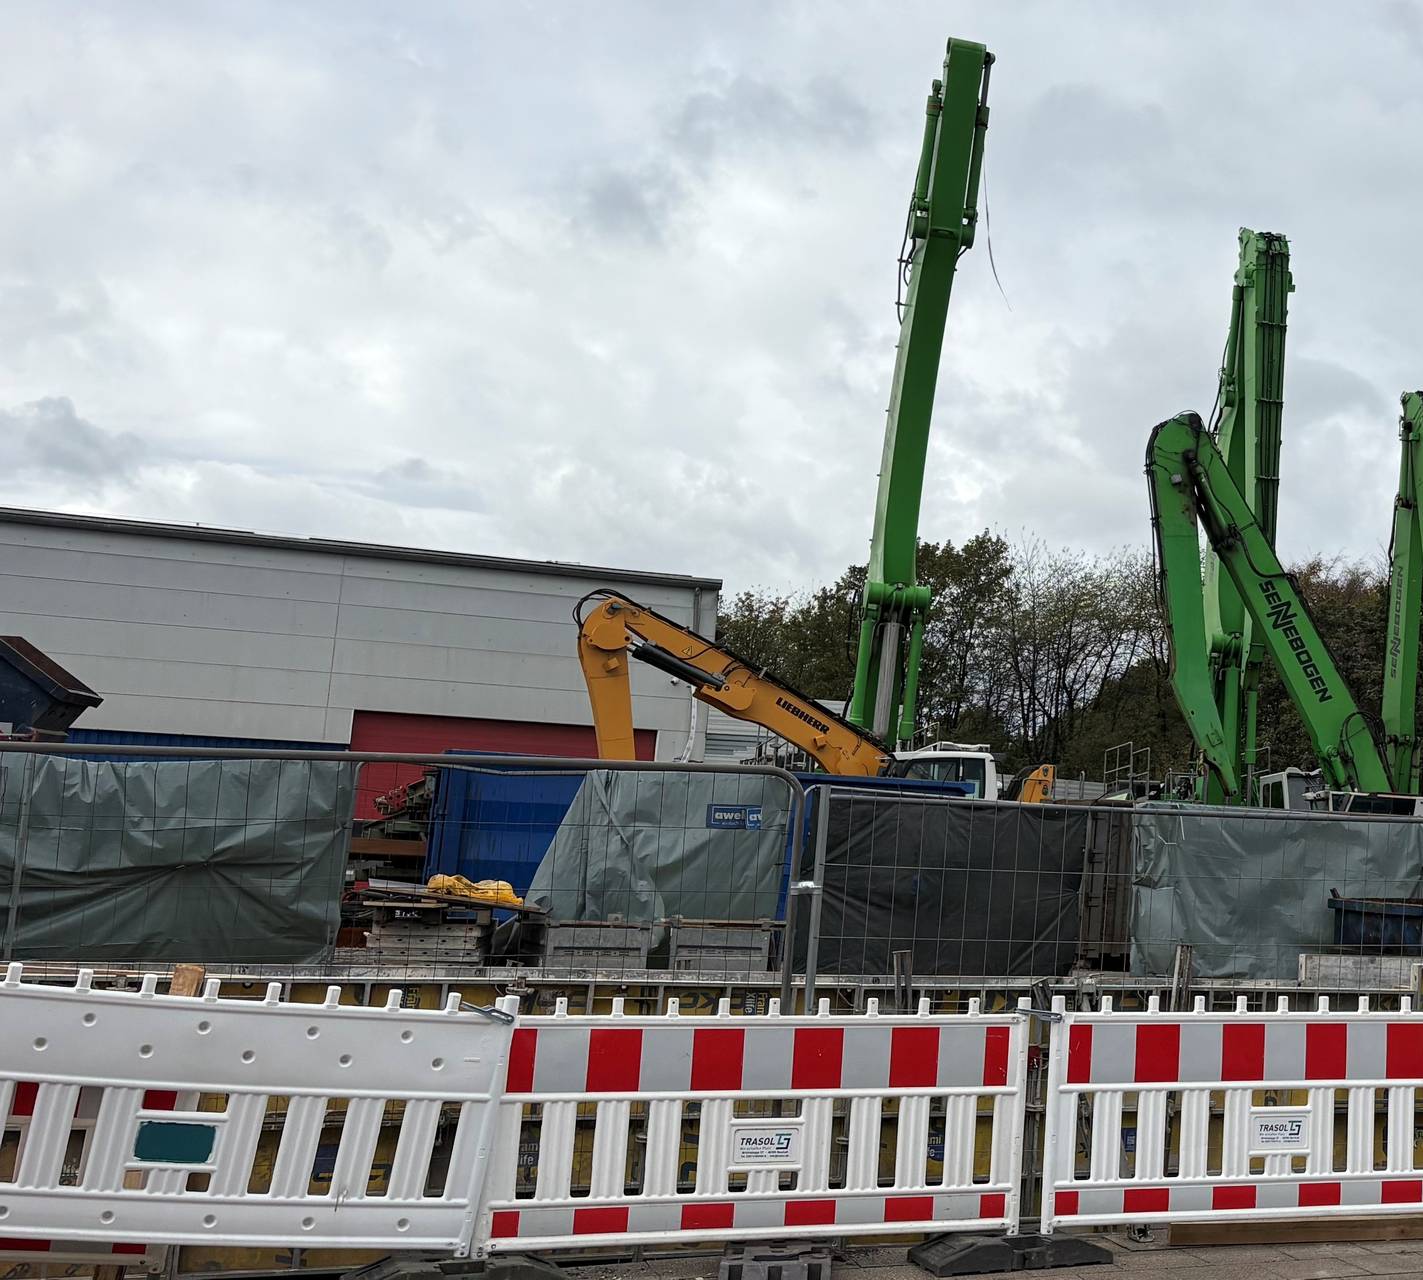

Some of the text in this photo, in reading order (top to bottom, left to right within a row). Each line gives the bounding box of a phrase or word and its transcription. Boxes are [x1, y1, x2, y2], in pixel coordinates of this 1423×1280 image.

[1258, 580, 1333, 703] SENNEBOGEN
[776, 697, 830, 734] LIEBHERR
[1260, 1124, 1288, 1132] TRASOL
[740, 1137, 775, 1146] TRASOL
